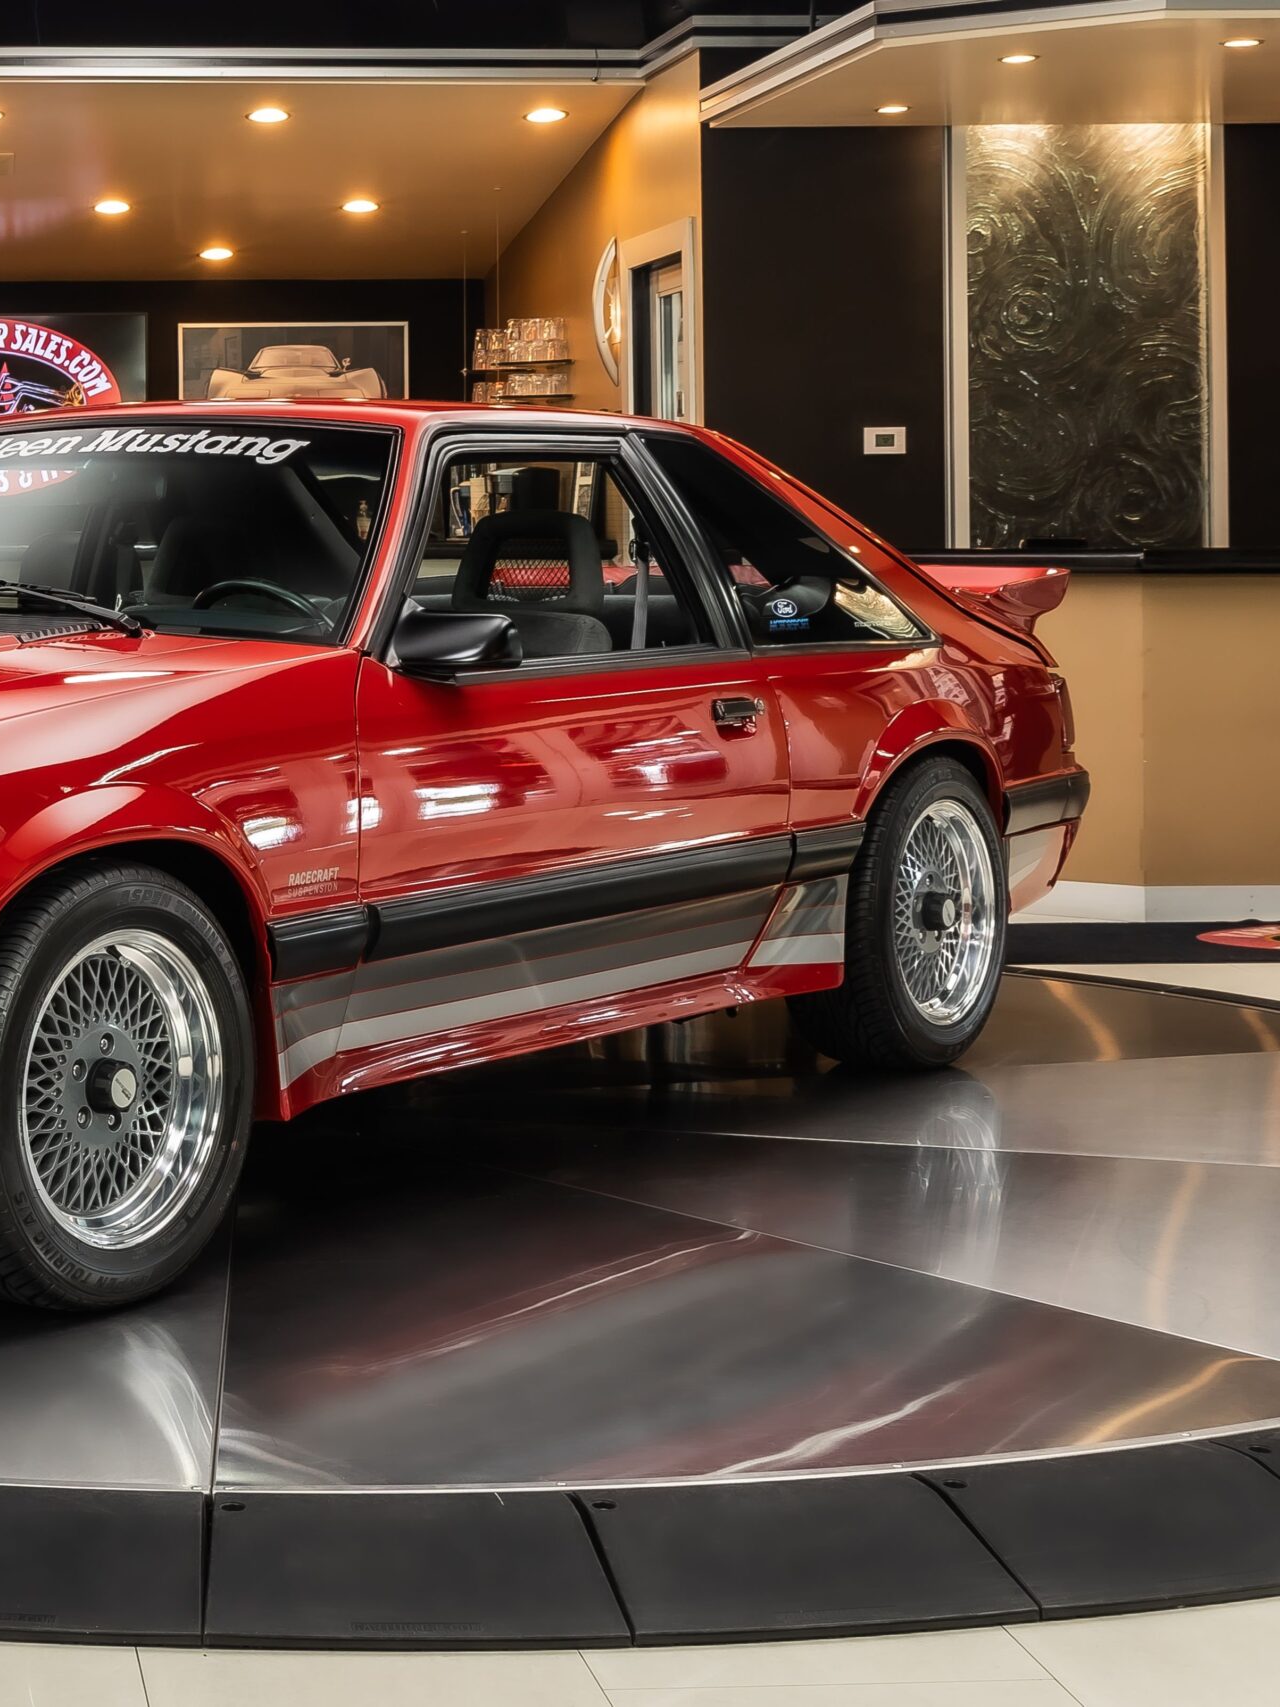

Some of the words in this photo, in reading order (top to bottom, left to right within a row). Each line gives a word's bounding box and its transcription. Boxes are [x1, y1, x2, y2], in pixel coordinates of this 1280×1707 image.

[10, 323, 113, 397] SALES.COM
[78, 429, 312, 465] Mustang
[288, 866, 340, 887] RACECRAFT
[32, 1231, 89, 1286] TOURING
